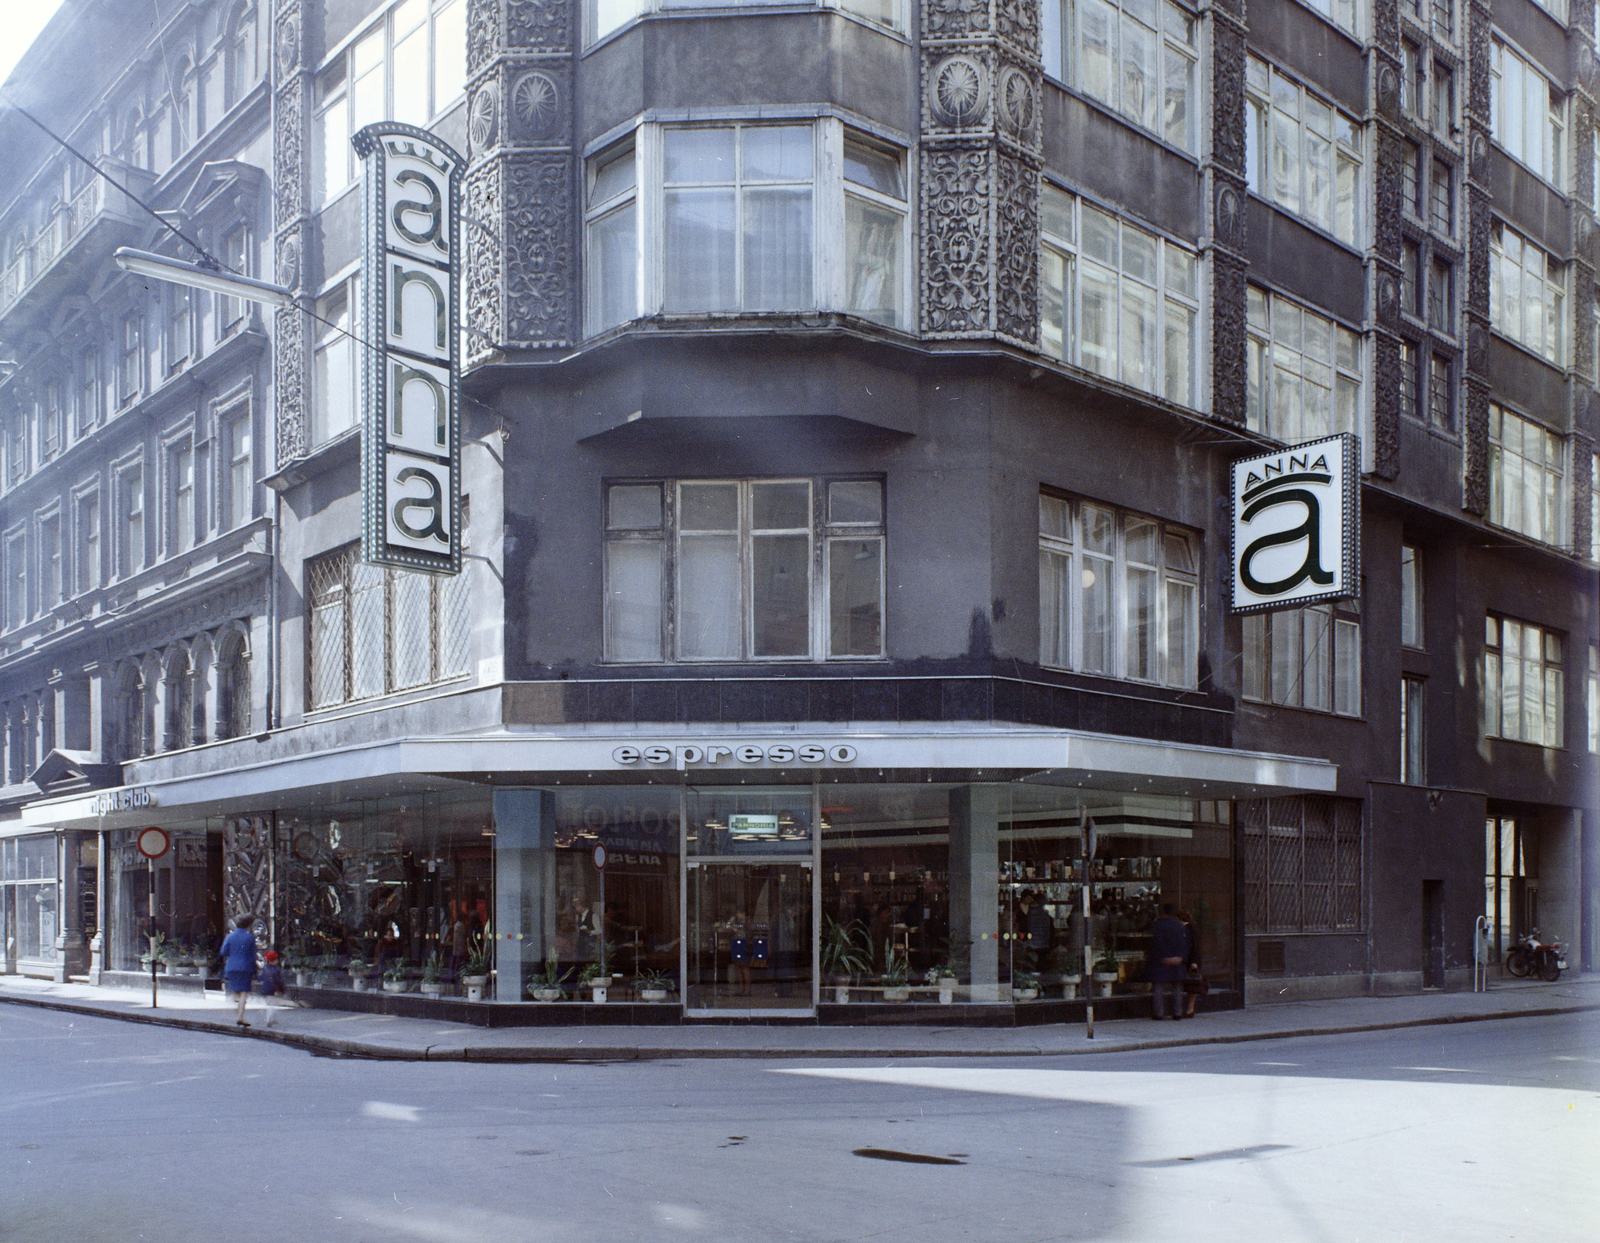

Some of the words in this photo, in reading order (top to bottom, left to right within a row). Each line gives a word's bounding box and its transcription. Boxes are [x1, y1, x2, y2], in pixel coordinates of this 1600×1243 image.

[391, 168, 450, 545] anna
[1245, 453, 1331, 490] ANNA
[612, 744, 858, 770] espresso
[90, 791, 120, 817] night
[123, 787, 150, 808] club
